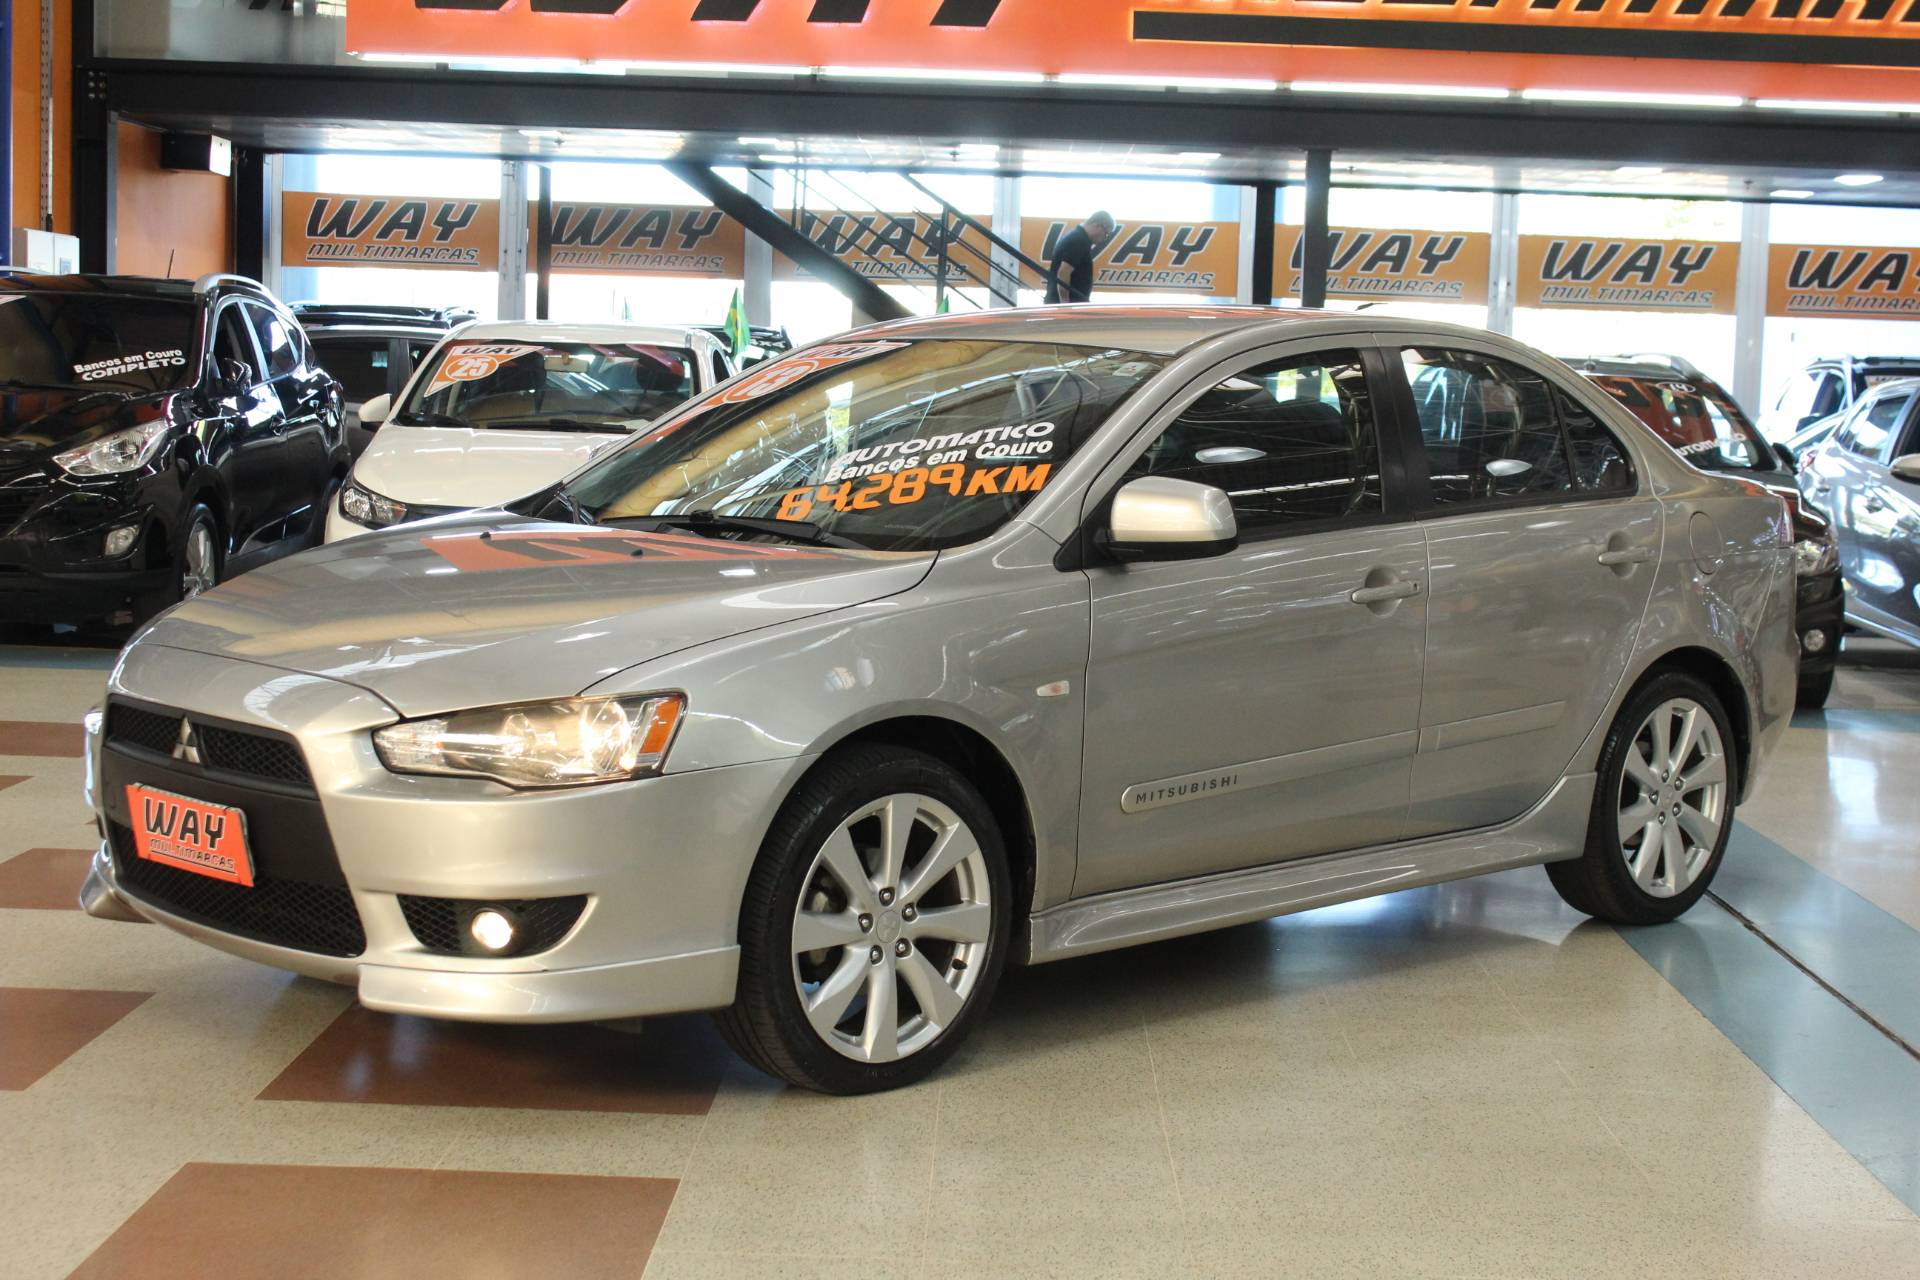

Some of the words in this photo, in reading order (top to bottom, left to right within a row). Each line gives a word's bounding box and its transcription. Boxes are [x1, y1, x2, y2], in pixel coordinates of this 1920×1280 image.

[306, 198, 480, 243] WAY
[552, 205, 725, 250] WAY
[306, 243, 480, 260] MULTIMARCAS
[552, 251, 724, 268] MULTIMARCAS
[1540, 240, 1717, 286] WAY
[1787, 248, 1920, 293] WA
[1541, 284, 1713, 303] MULTIMARCAS
[1788, 294, 1920, 311] MULTIMAR
[73, 356, 122, 374] Bancos
[123, 355, 144, 364] em
[145, 349, 183, 361] Couro
[461, 347, 521, 355] WAY
[81, 356, 186, 382] COMPLETO
[450, 357, 490, 377] 25
[831, 421, 1055, 469] AUTOMATICO
[824, 454, 920, 483] Bancos
[926, 449, 968, 466] em
[975, 440, 1054, 459] Couro
[1135, 774, 1238, 805] MITSUBISHI
[143, 796, 226, 850] WAY
